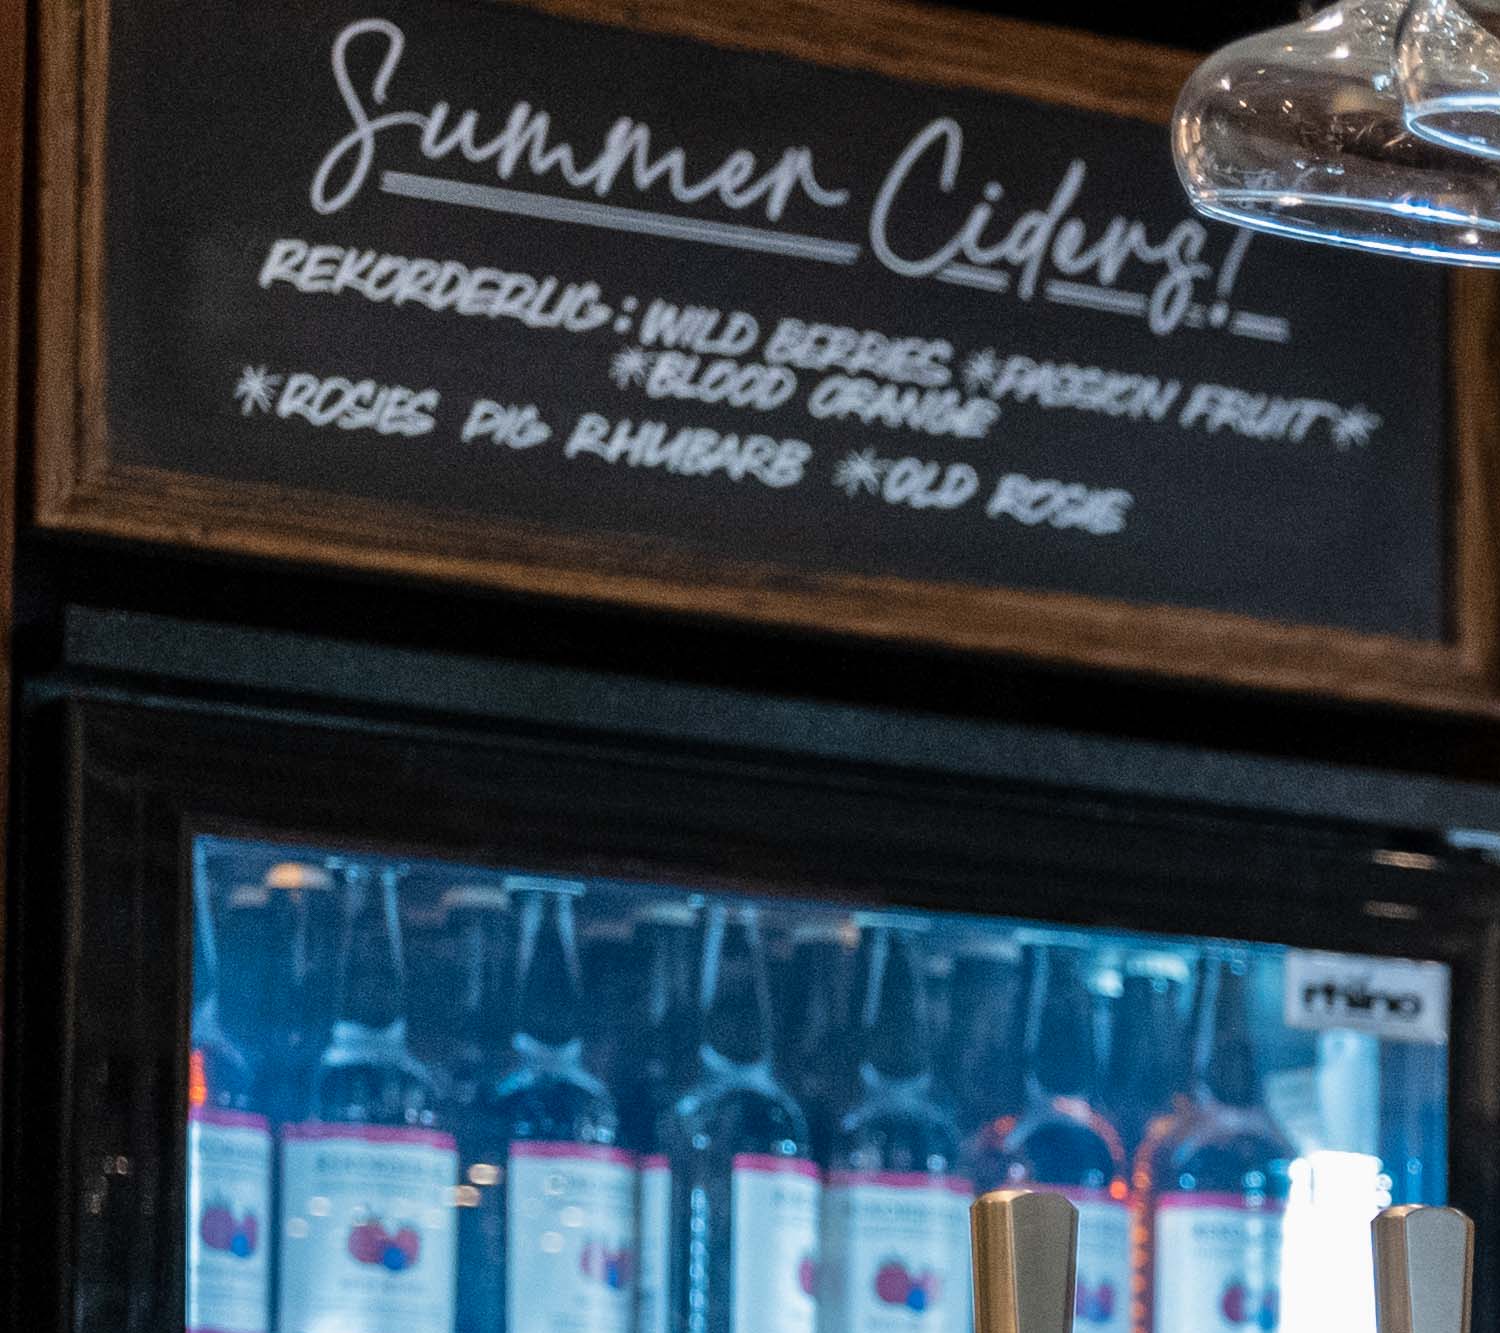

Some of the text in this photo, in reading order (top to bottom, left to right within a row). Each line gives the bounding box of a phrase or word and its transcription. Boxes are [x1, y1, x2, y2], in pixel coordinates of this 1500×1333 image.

[309, 16, 849, 220] Summer
[638, 297, 760, 357] WILD
[644, 351, 798, 411] BLOOD
[881, 456, 980, 510] OLD
